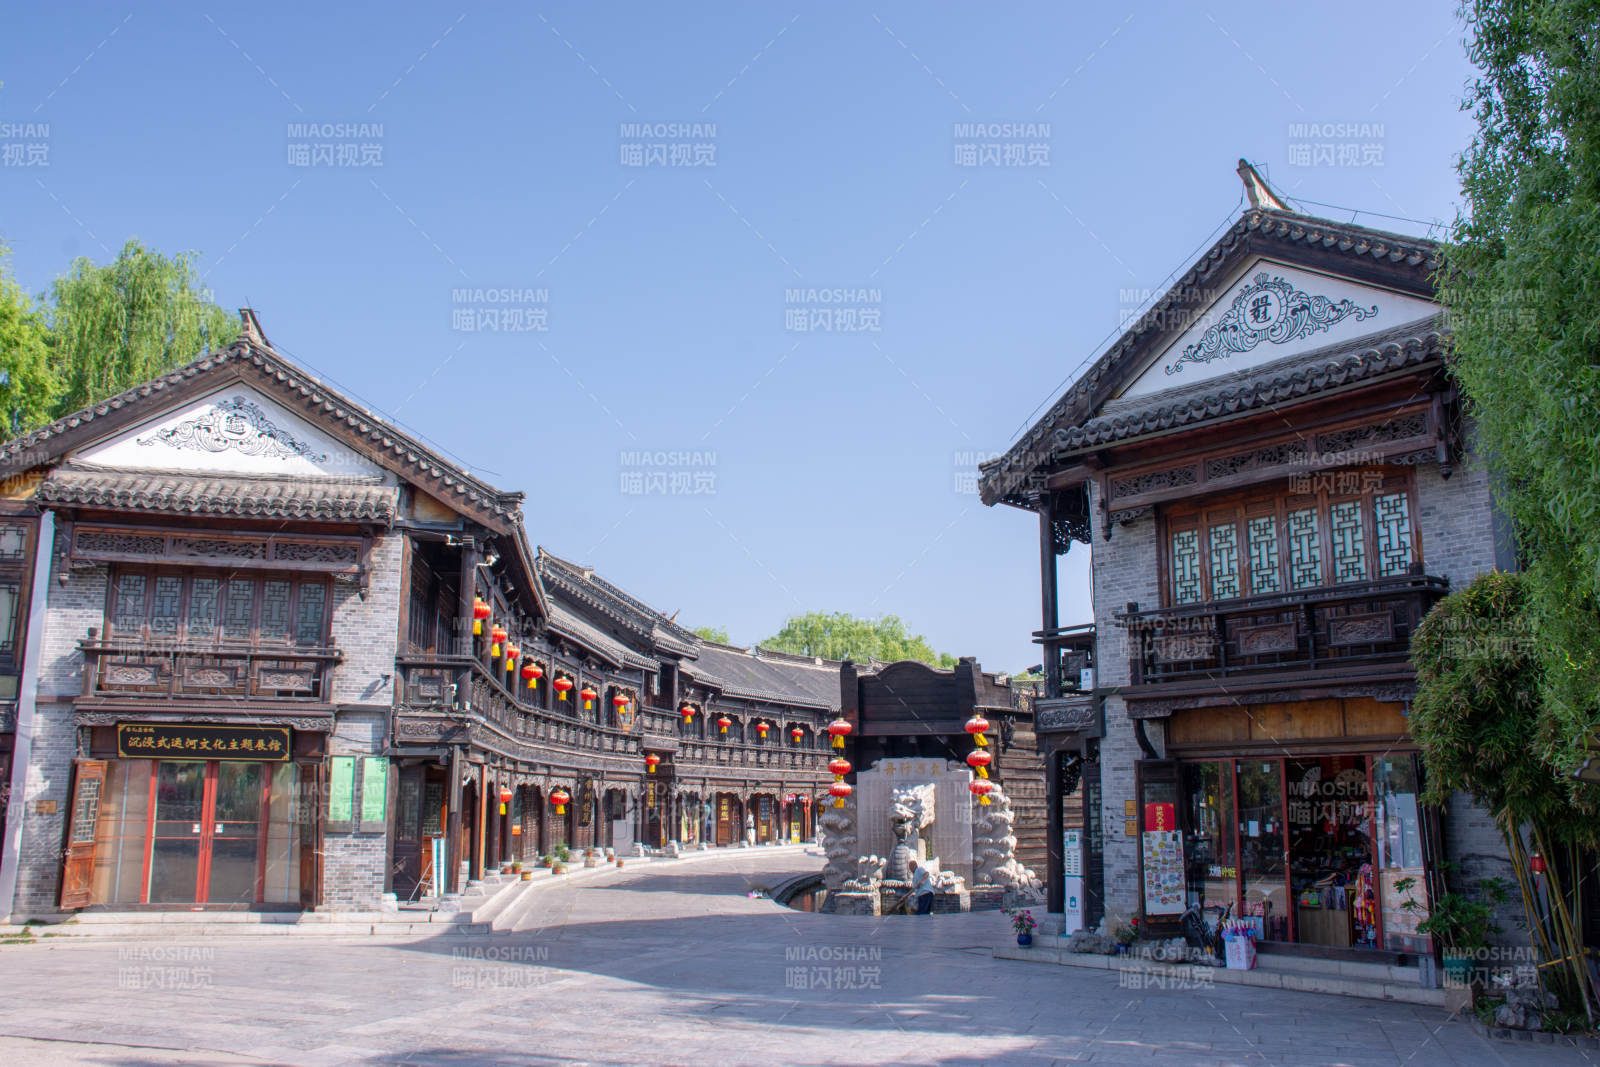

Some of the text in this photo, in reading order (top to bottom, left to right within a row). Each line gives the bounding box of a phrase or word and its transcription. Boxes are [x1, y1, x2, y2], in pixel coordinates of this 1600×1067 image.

[128, 736, 282, 751] 沉浸式运河文化主题展馆
